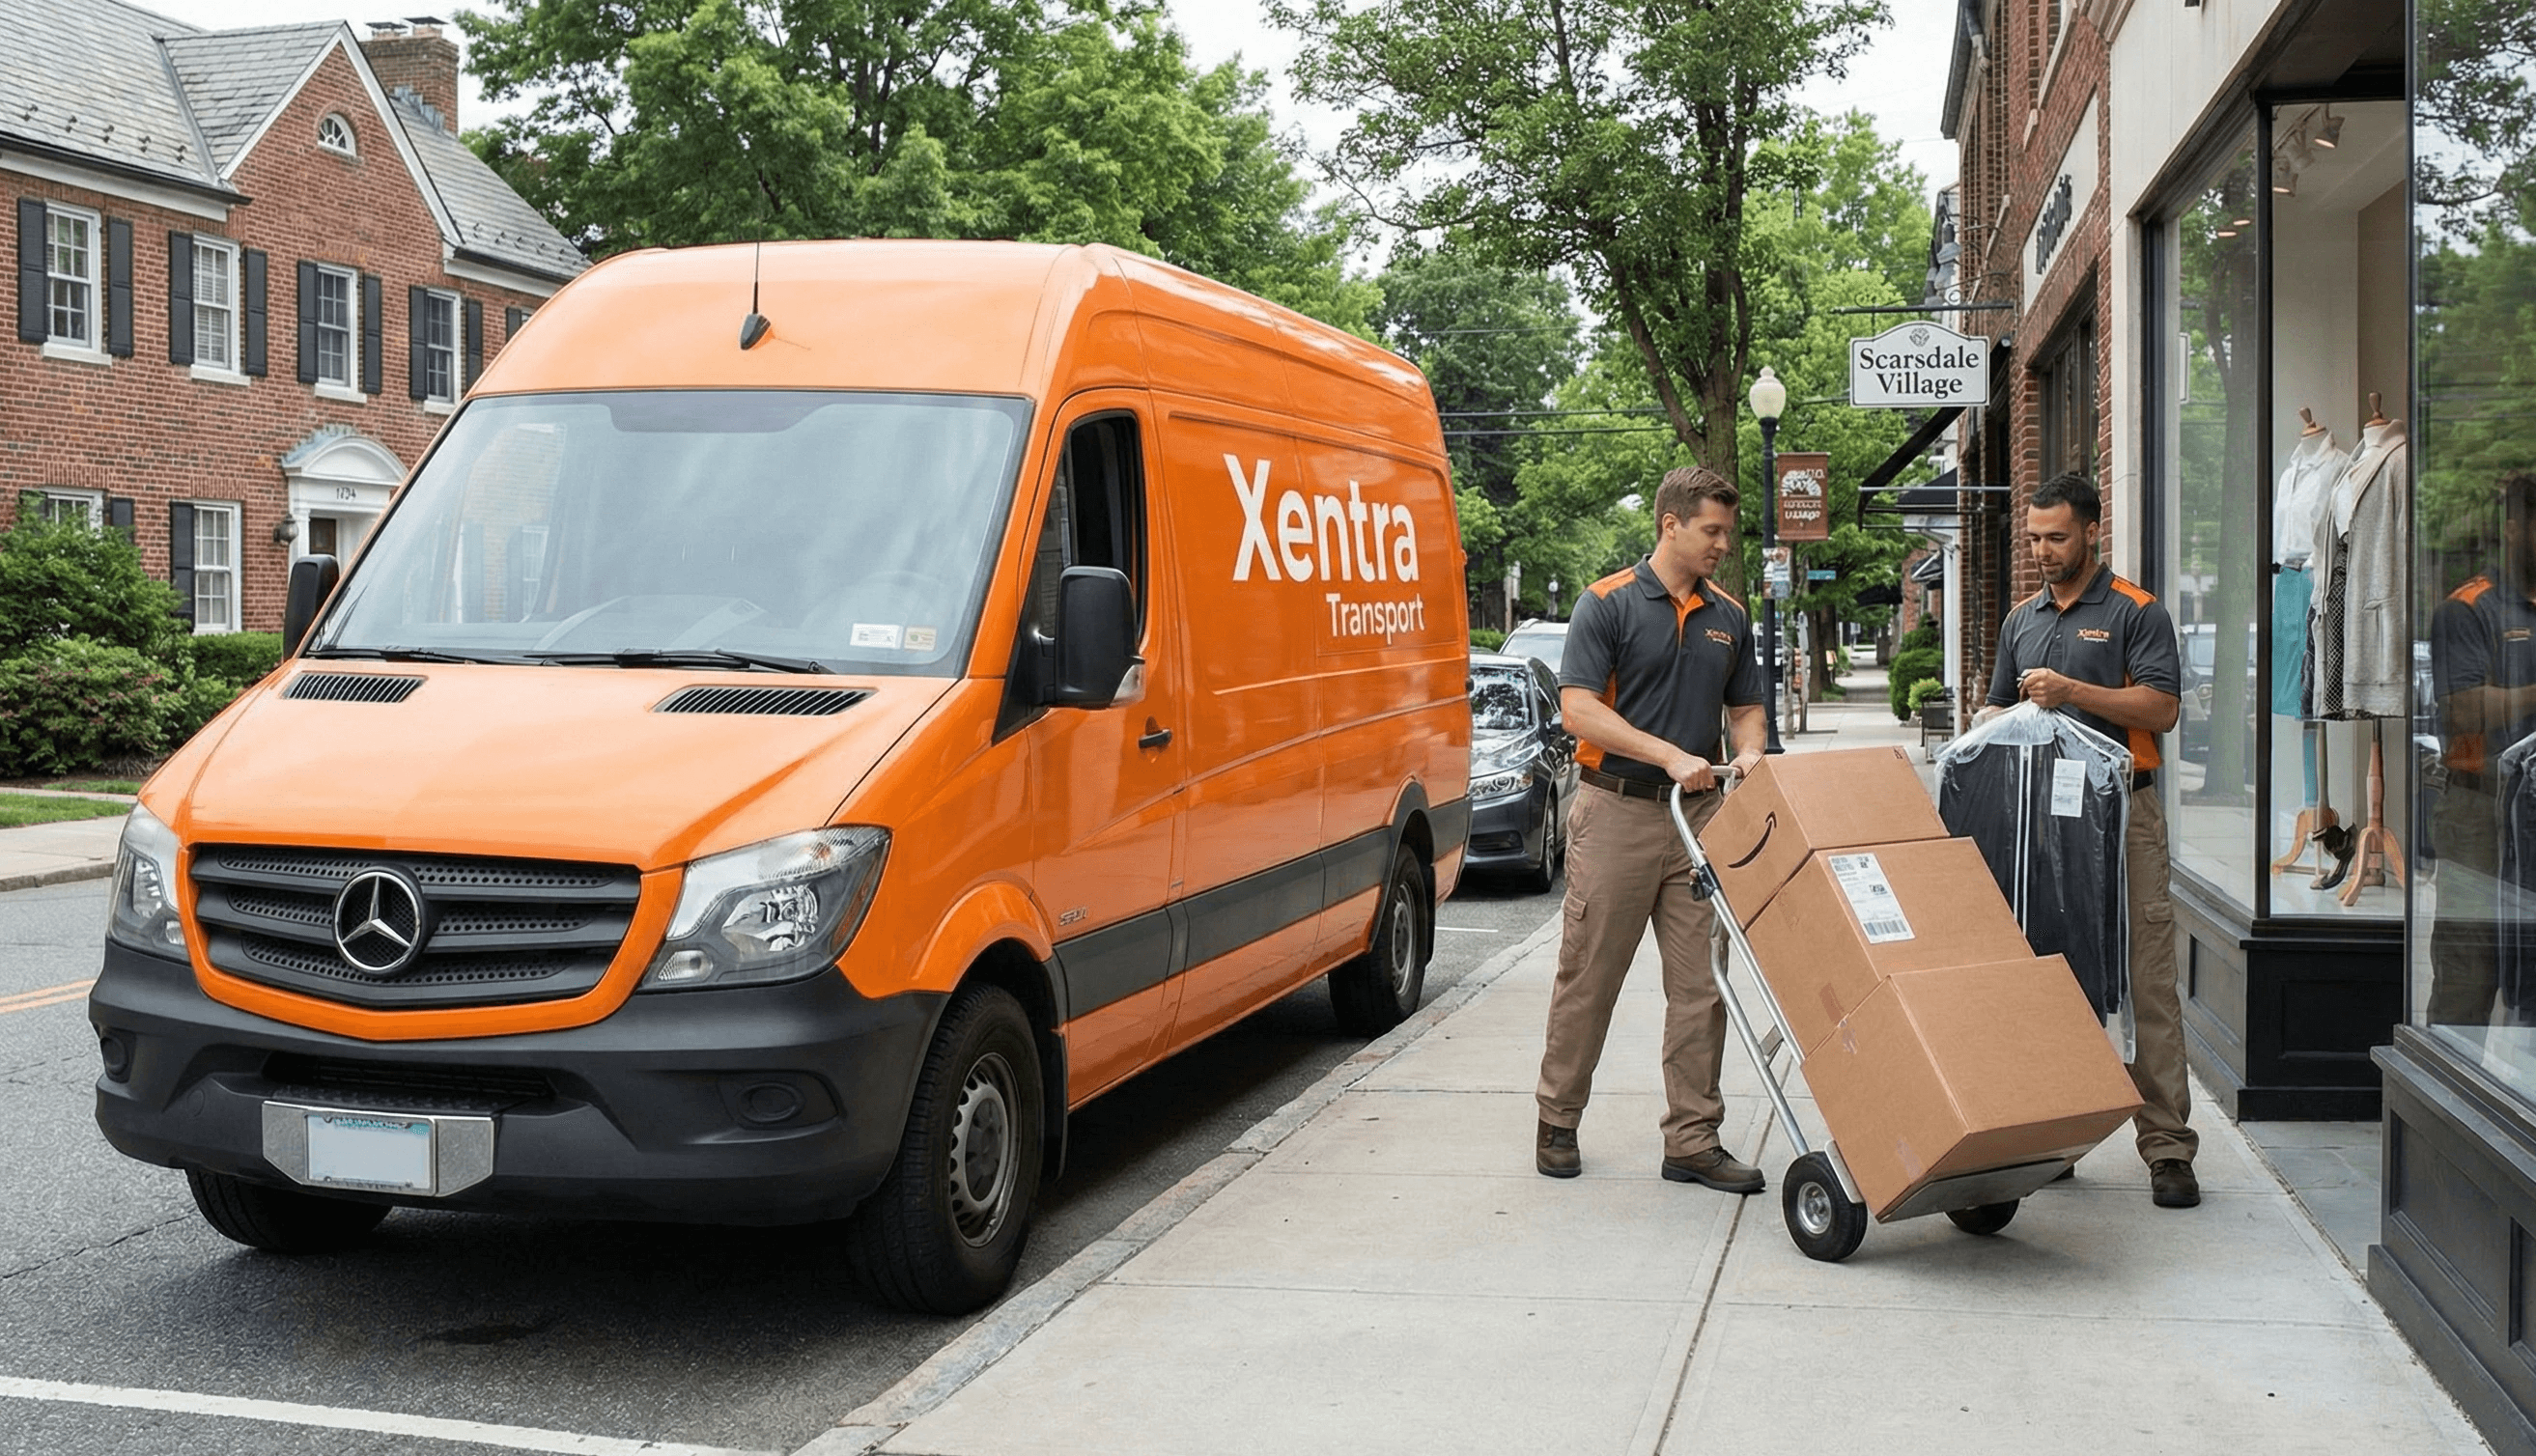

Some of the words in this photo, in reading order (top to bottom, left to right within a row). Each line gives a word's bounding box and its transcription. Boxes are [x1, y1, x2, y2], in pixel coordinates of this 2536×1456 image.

[1860, 345, 1980, 370] Scarsdale
[1876, 371, 1963, 400] Village
[1223, 453, 1420, 582] Xentra
[1326, 593, 1425, 645] Transport
